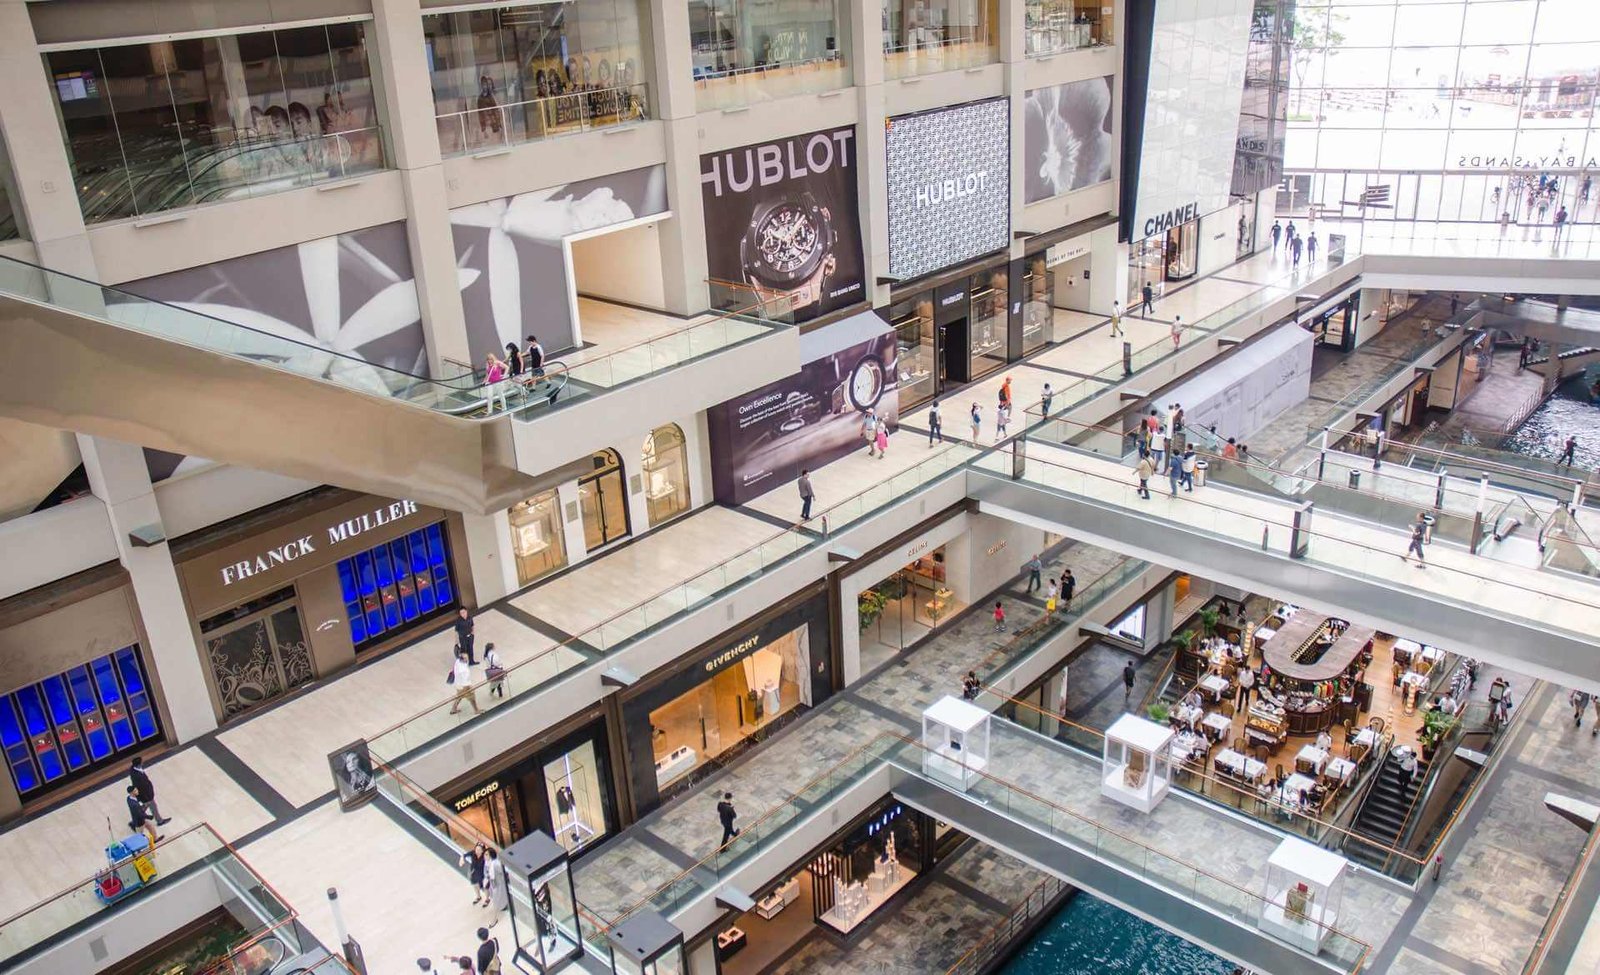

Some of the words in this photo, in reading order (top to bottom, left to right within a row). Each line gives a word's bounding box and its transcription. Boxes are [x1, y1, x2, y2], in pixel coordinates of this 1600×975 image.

[700, 129, 852, 197] HUBLOT
[917, 171, 987, 208] HUBLOT
[1145, 202, 1200, 236] CHANEL
[739, 404, 753, 414] Own
[753, 393, 782, 409] Excellence
[220, 535, 316, 585] FRANCK
[326, 498, 418, 545] MULLER
[705, 635, 760, 671] GIVENCHY
[455, 794, 475, 811] TOM
[475, 781, 499, 800] FORD
